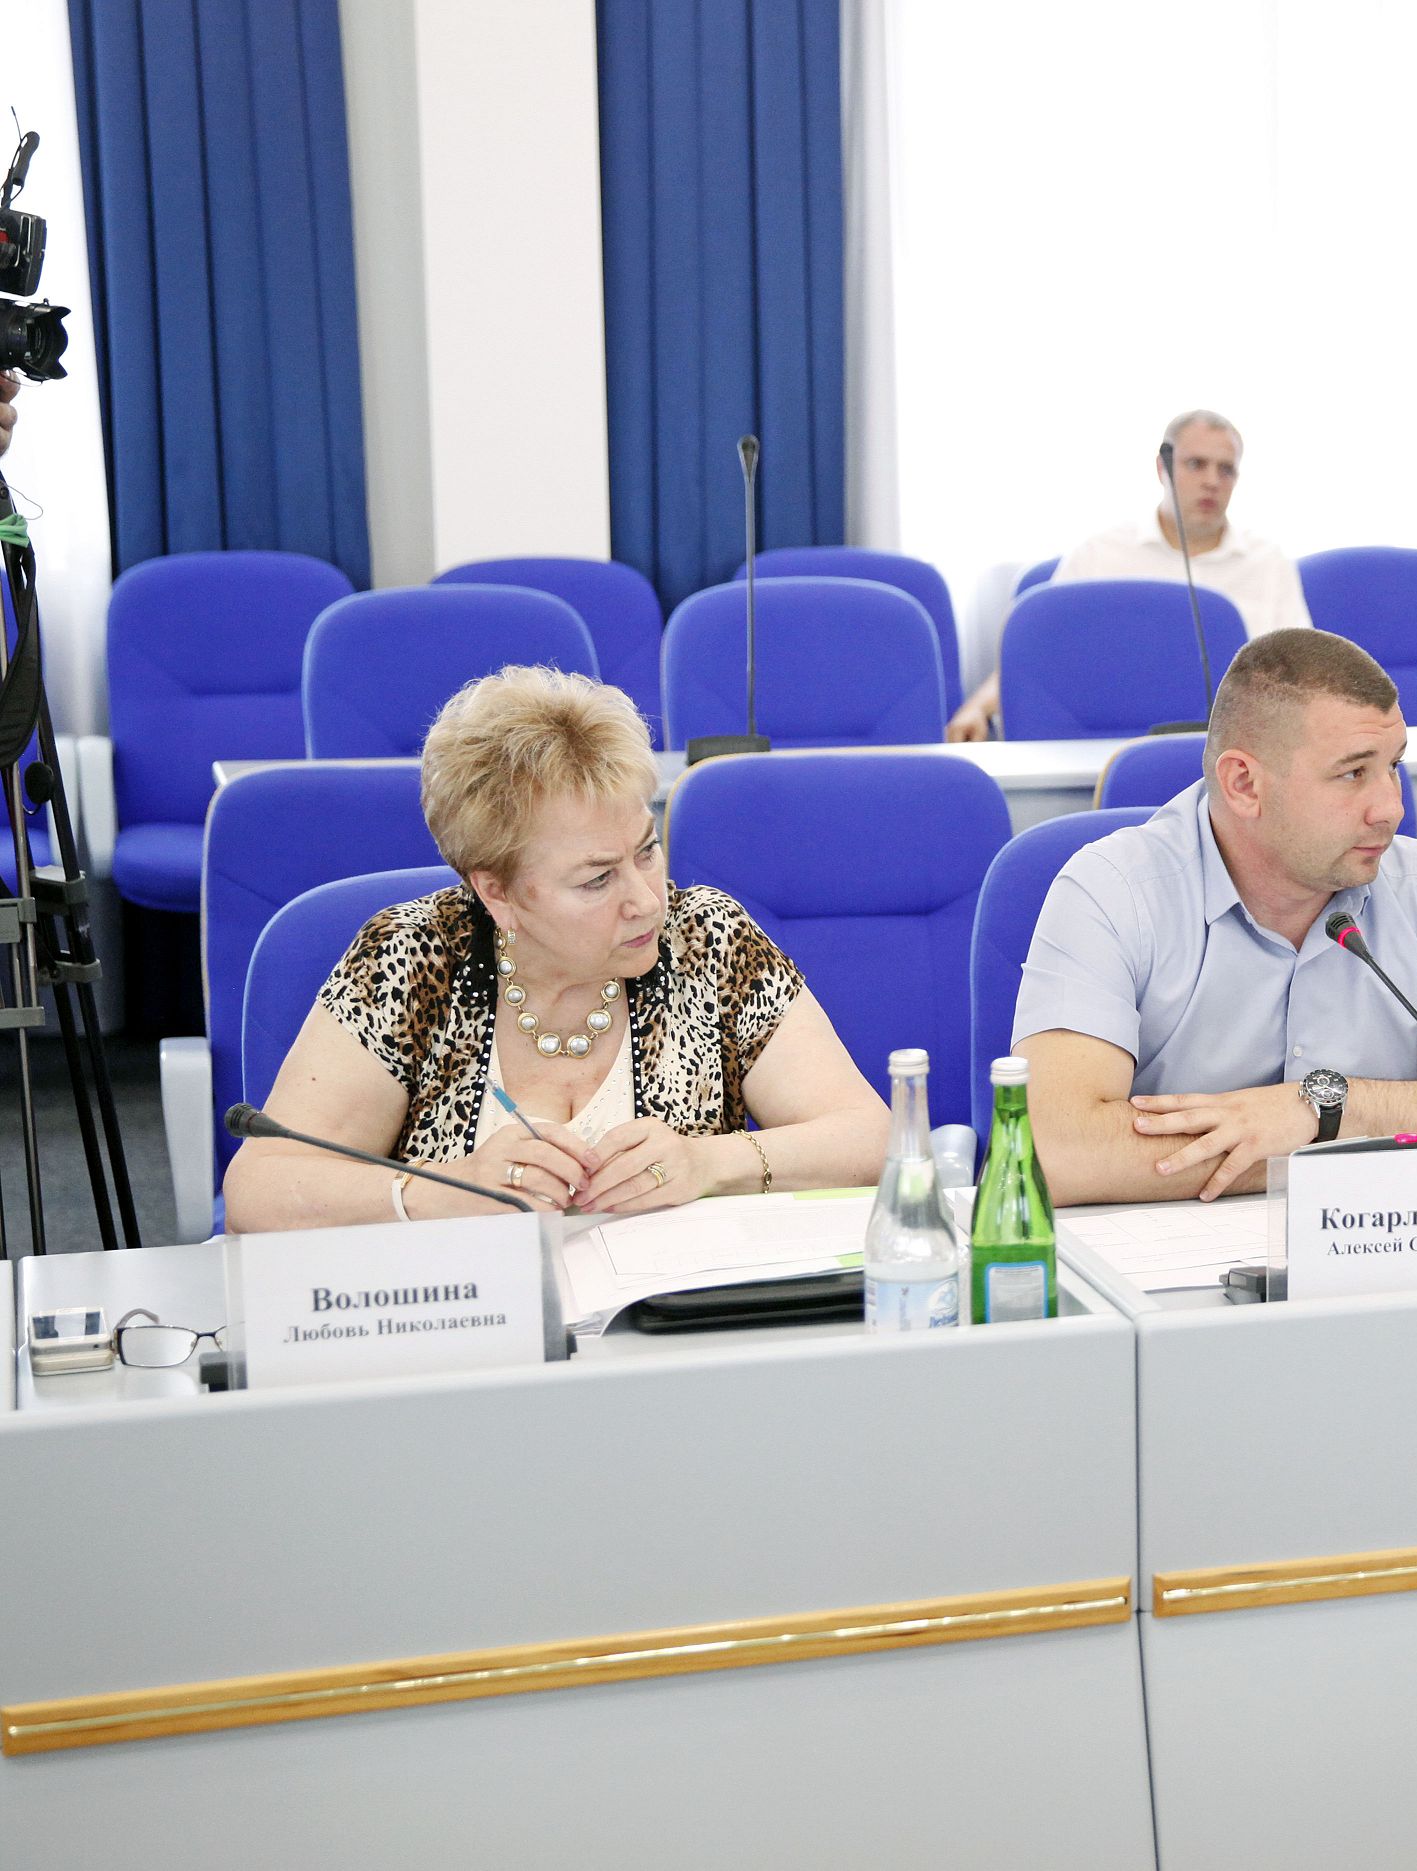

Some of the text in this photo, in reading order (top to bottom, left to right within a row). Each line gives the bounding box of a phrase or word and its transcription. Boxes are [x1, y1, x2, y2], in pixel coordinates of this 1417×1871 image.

[1327, 1237, 1402, 1256] Алексей
[311, 1281, 479, 1312] Волошина
[283, 1313, 507, 1344] Любовь Николаевна
